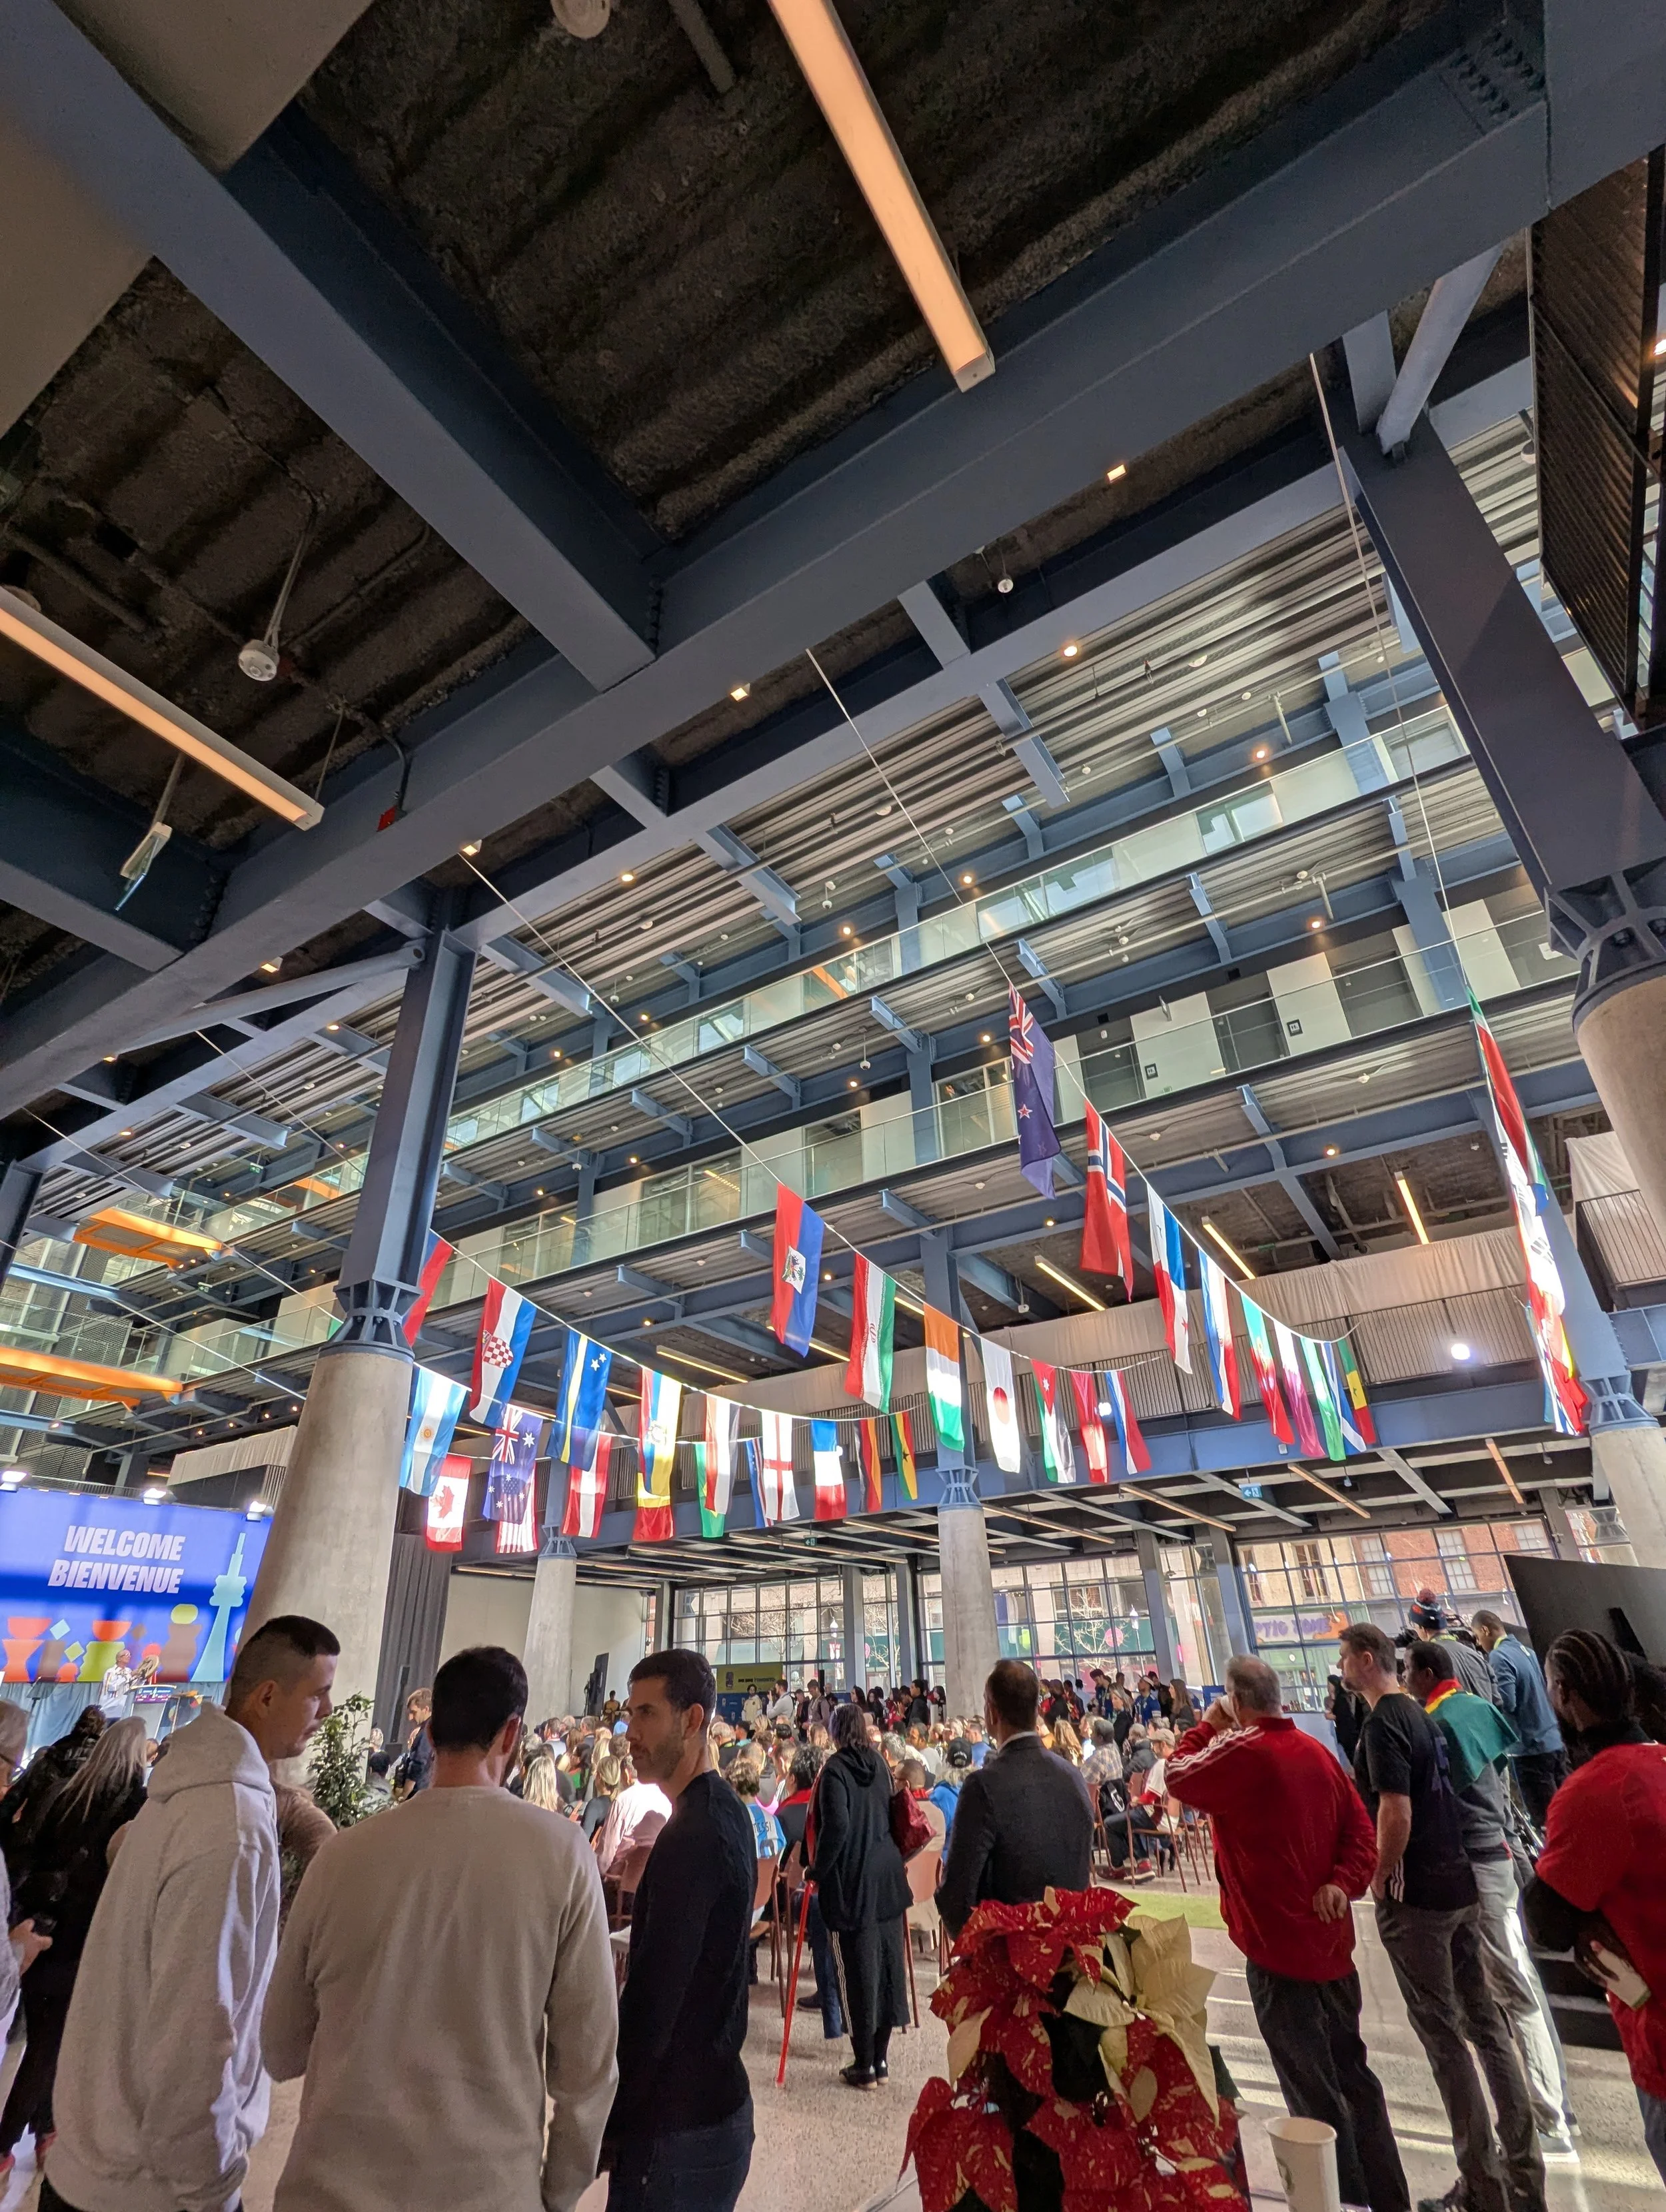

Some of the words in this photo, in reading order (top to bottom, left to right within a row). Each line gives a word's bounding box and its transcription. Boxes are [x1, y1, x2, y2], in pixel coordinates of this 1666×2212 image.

[64, 1525, 186, 1561] WELCOME
[47, 1559, 185, 1594] BIENVENUE
[1255, 1620, 1289, 1638] PTIC
